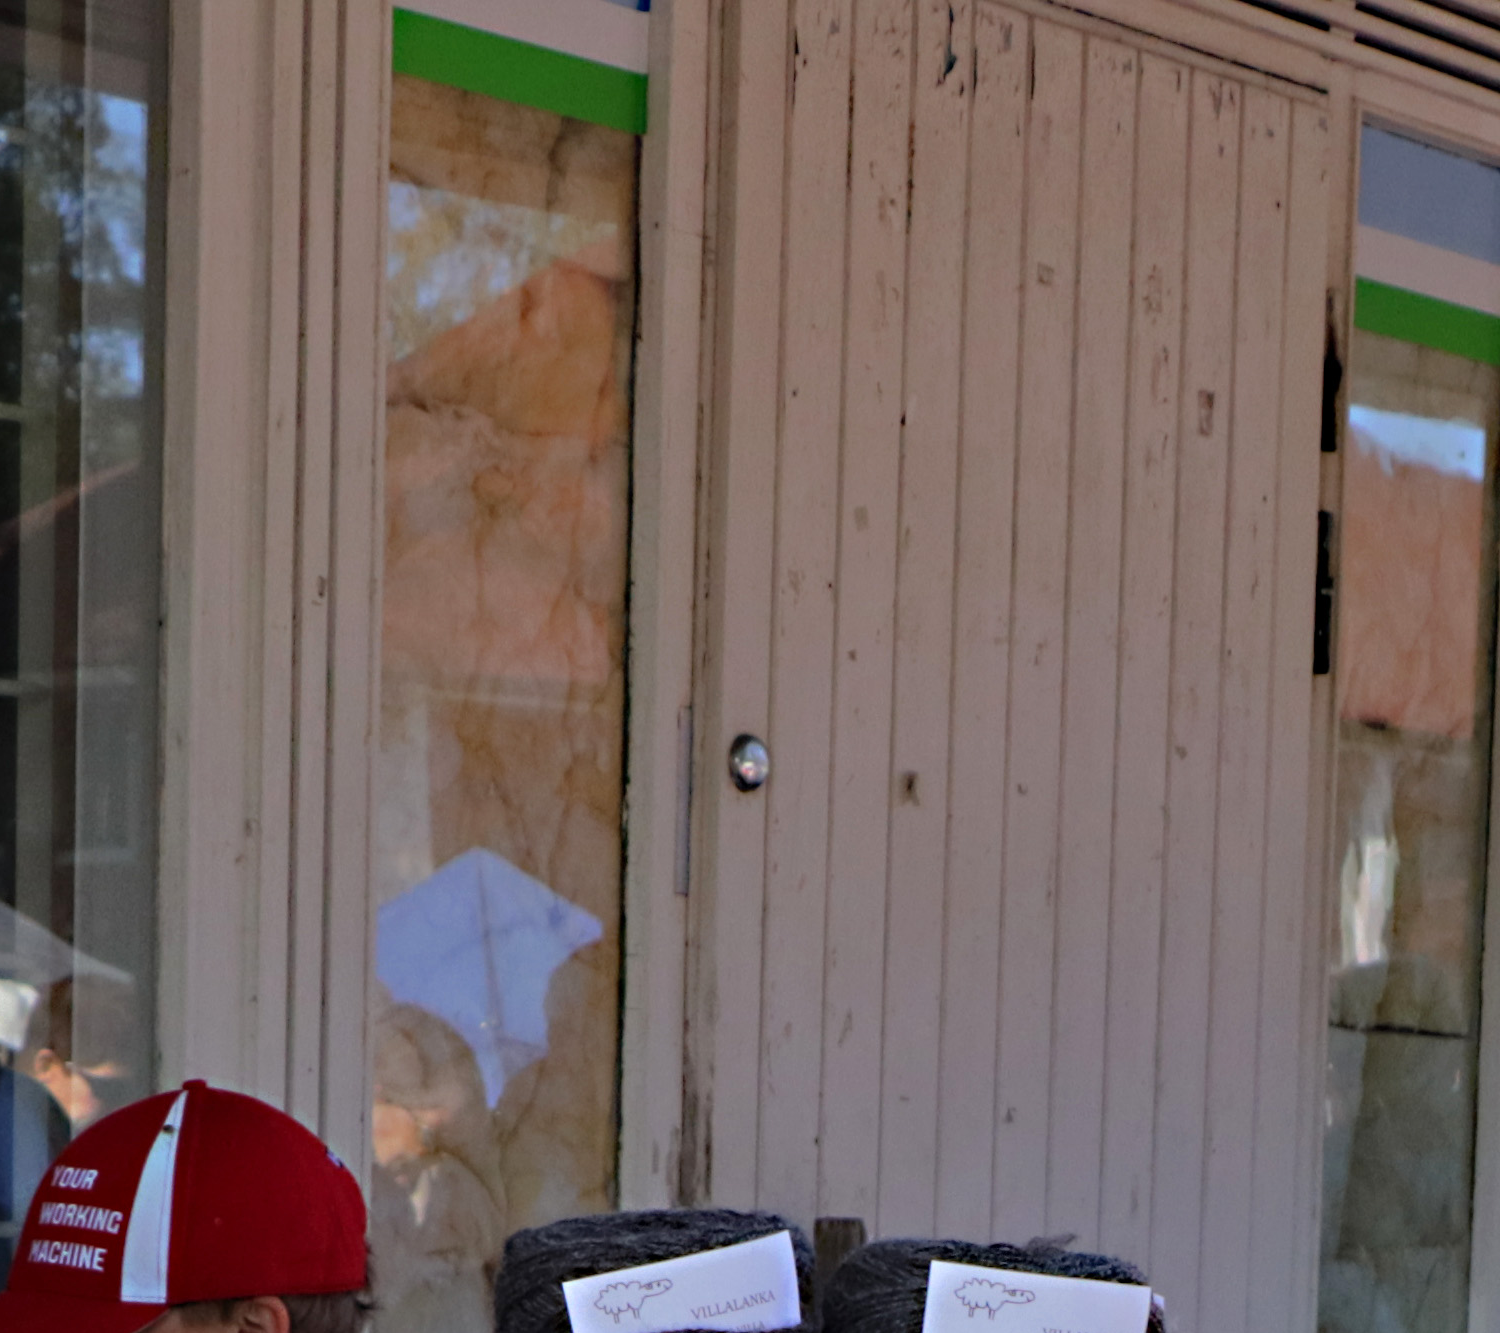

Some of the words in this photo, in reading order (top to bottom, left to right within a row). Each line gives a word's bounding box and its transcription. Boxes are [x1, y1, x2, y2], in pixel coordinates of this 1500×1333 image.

[51, 1165, 98, 1190] YOUR
[38, 1201, 124, 1235] WORKING
[27, 1239, 108, 1272] MACHINE
[690, 1289, 776, 1320] VILLALANKA
